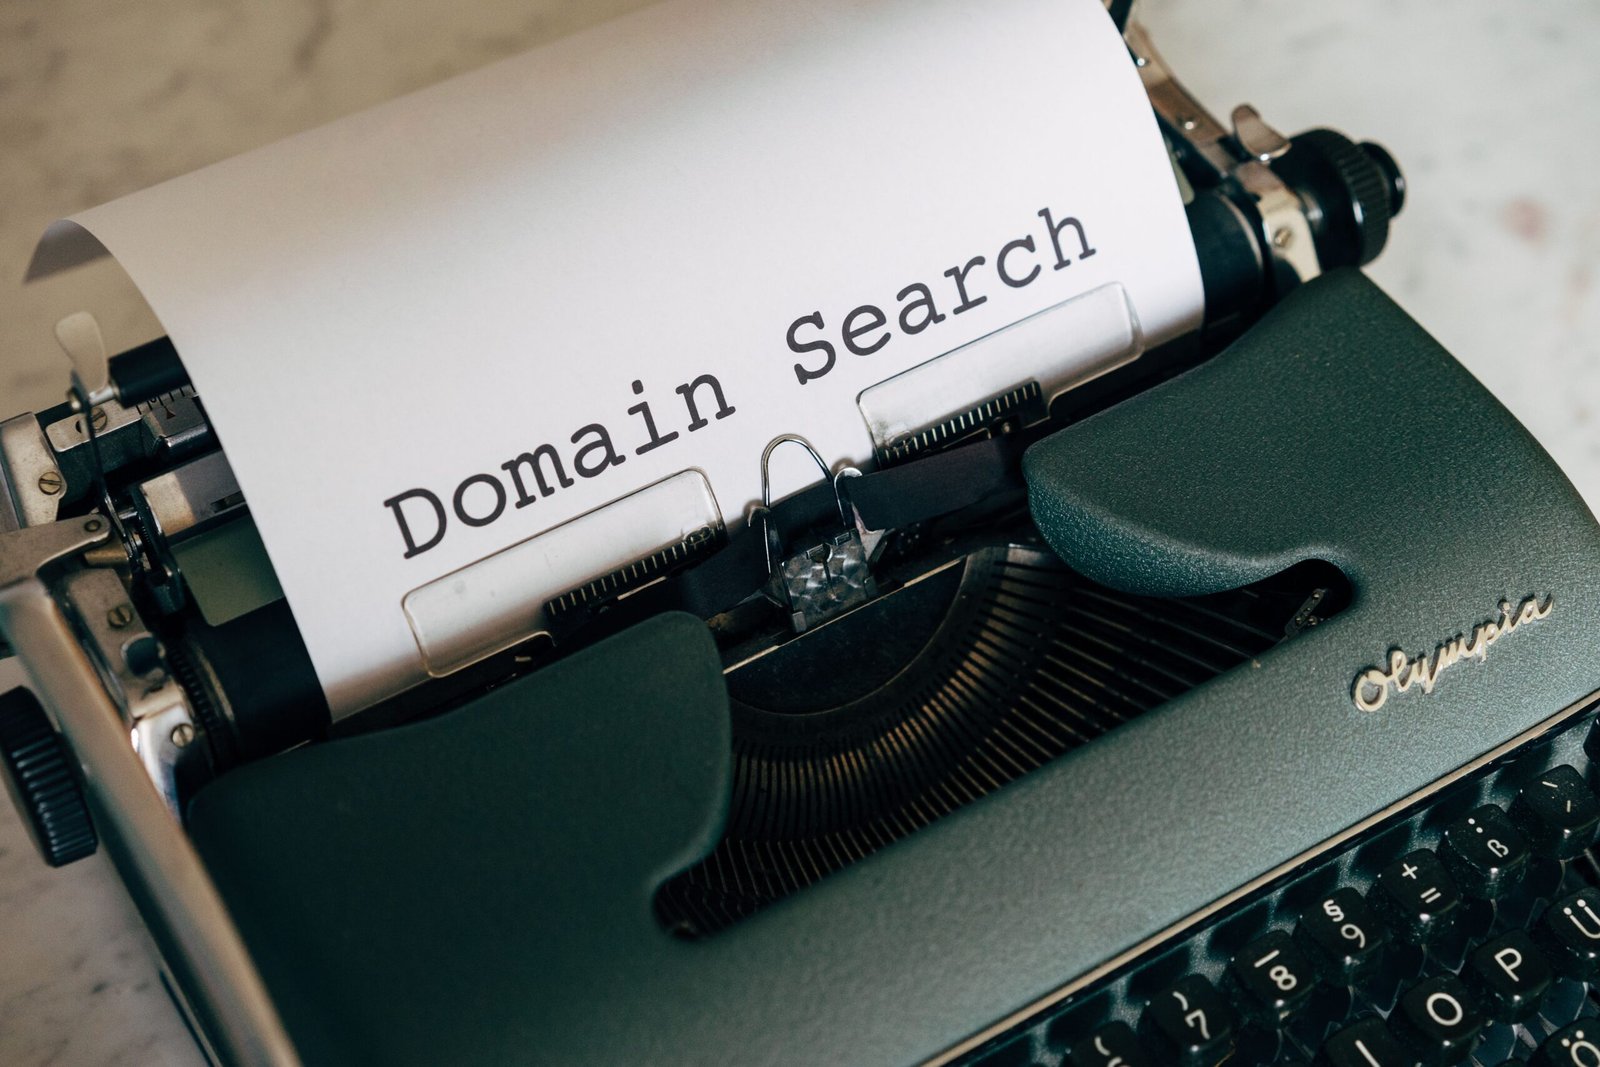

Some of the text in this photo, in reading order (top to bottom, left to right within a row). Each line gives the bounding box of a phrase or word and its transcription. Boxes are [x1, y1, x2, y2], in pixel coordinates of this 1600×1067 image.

[383, 206, 1097, 560] Domain Search
[1353, 594, 1554, 712] Olympia
[1340, 923, 1366, 949] 9
[1269, 965, 1298, 991] 8
[1494, 947, 1523, 983] P
[1184, 1009, 1211, 1040] 7
[1426, 992, 1464, 1027] O
